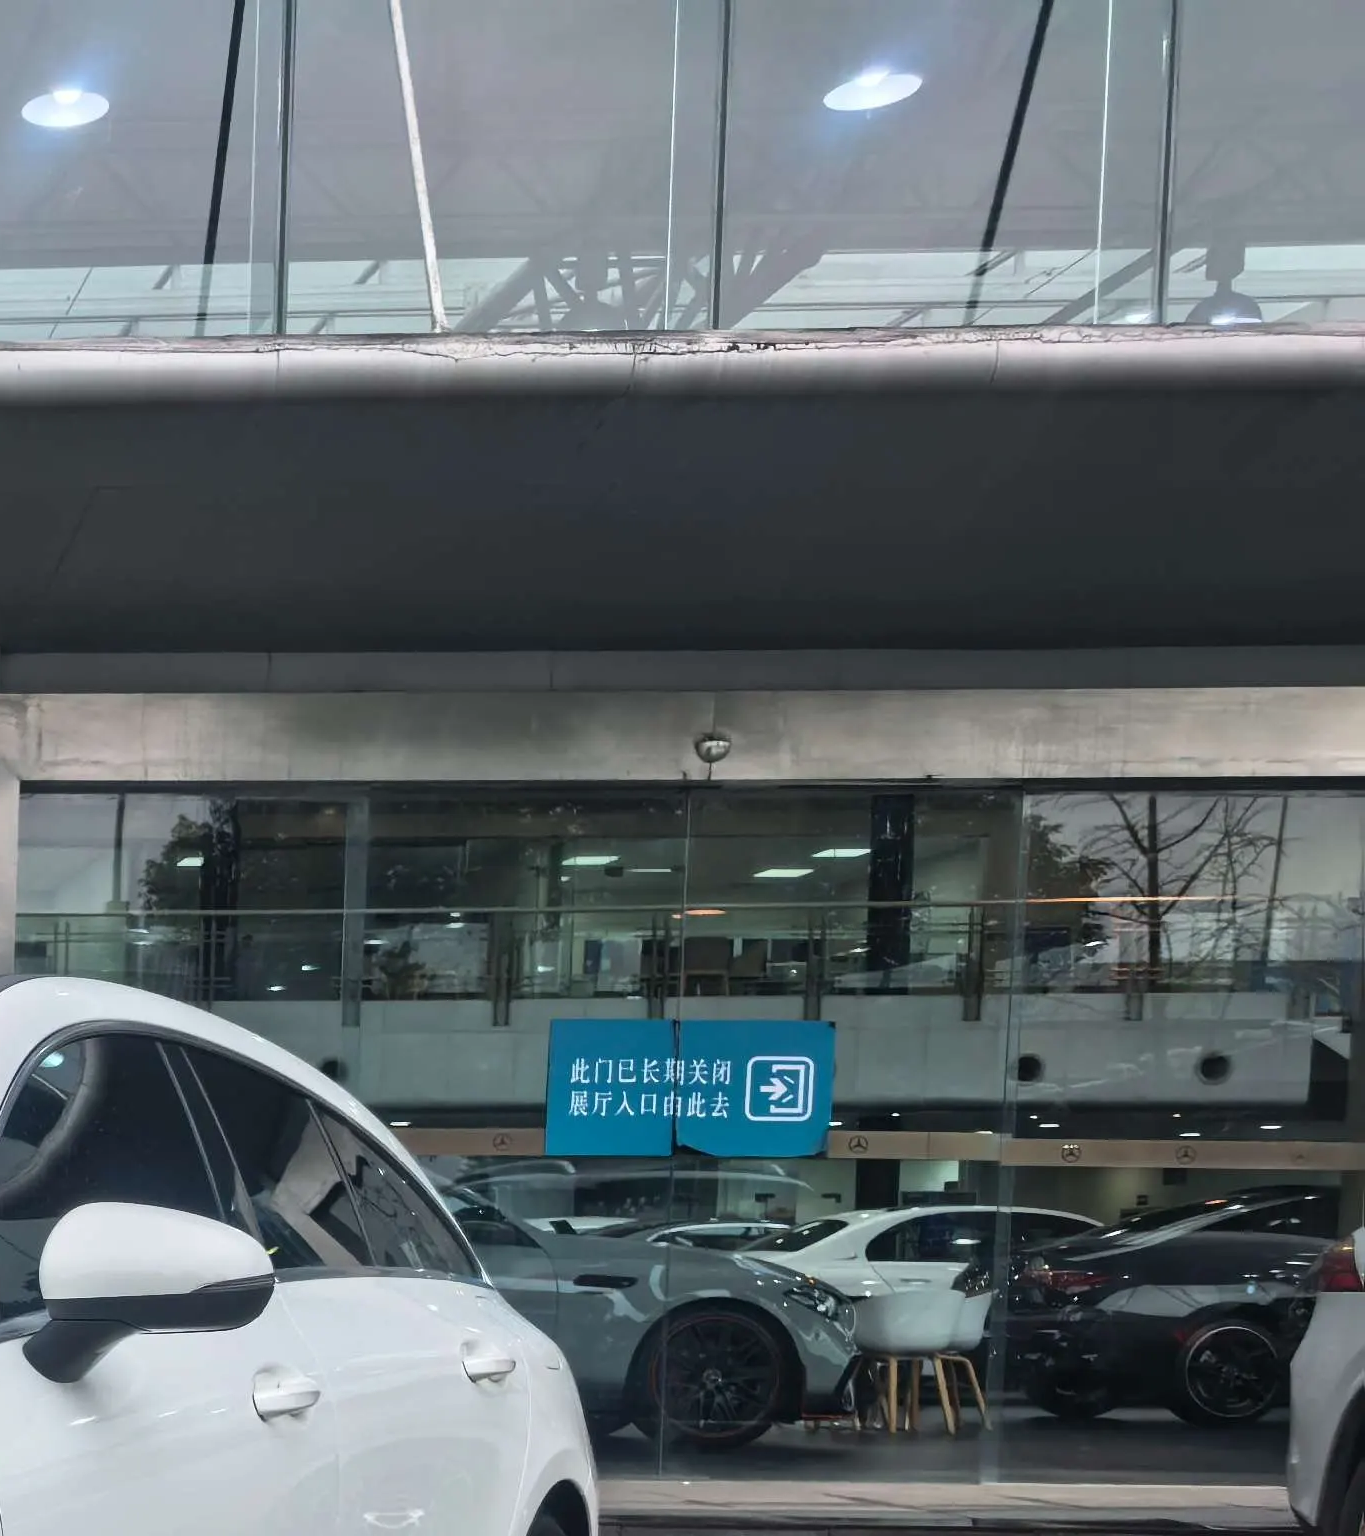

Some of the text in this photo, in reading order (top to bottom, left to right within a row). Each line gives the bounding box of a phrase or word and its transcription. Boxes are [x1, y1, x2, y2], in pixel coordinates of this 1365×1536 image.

[570, 1058, 732, 1085] 此门已长期关闭
[569, 1090, 730, 1118] 展厅入口由此去
